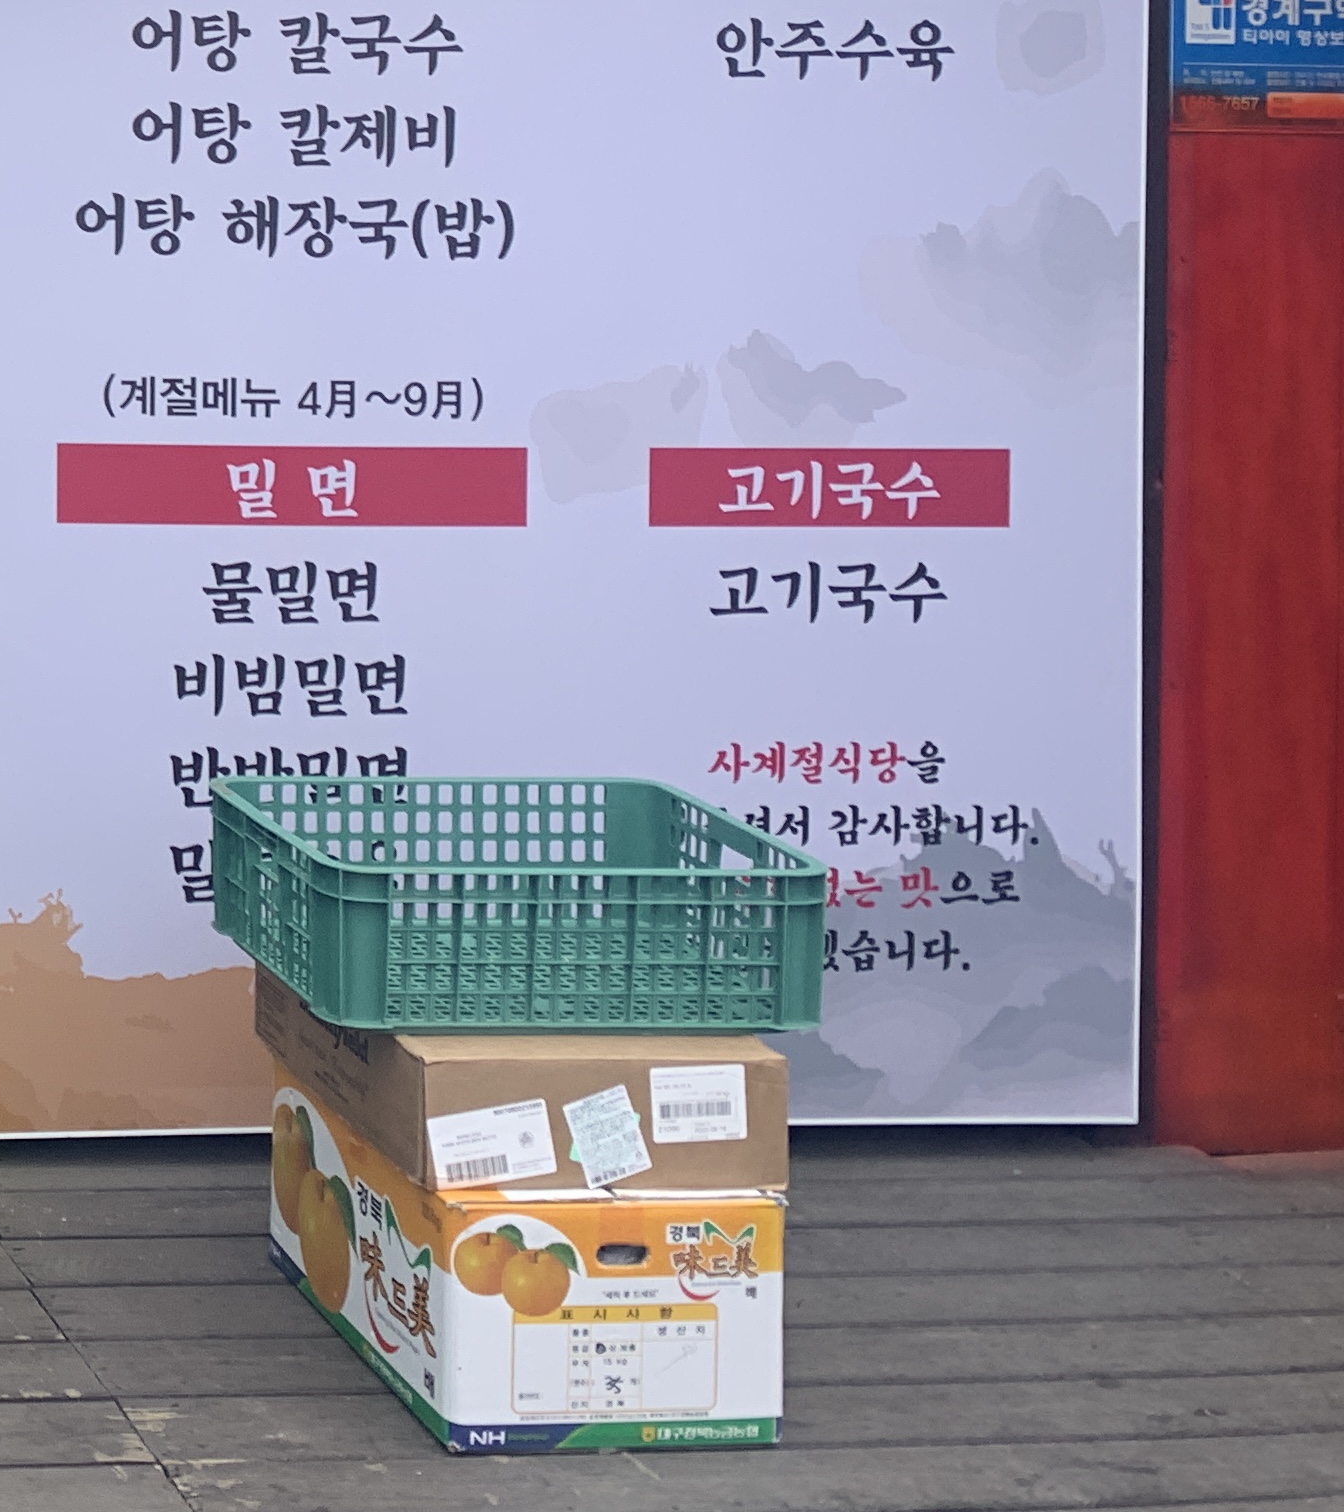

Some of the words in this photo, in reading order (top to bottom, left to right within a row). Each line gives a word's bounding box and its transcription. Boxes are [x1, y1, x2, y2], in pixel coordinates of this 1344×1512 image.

[131, 9, 252, 73] 어탕
[279, 11, 464, 76] 칼국수
[716, 17, 956, 82] 안주수육
[132, 101, 252, 165] 어탕
[279, 103, 456, 169] 칼제비
[75, 192, 196, 256] 어탕
[221, 195, 515, 261] 해장국(밥)
[103, 373, 281, 419] (계절메뉴
[718, 460, 941, 520] 고기국수
[202, 560, 380, 625] 물밀면
[709, 560, 948, 624] 고기국수
[173, 653, 408, 718] 비빔밀면
[707, 739, 946, 785] 사계절식당을
[828, 803, 1040, 847] 감사합니다.
[899, 867, 1021, 909] 맛으로
[469, 1430, 506, 1446] NH
